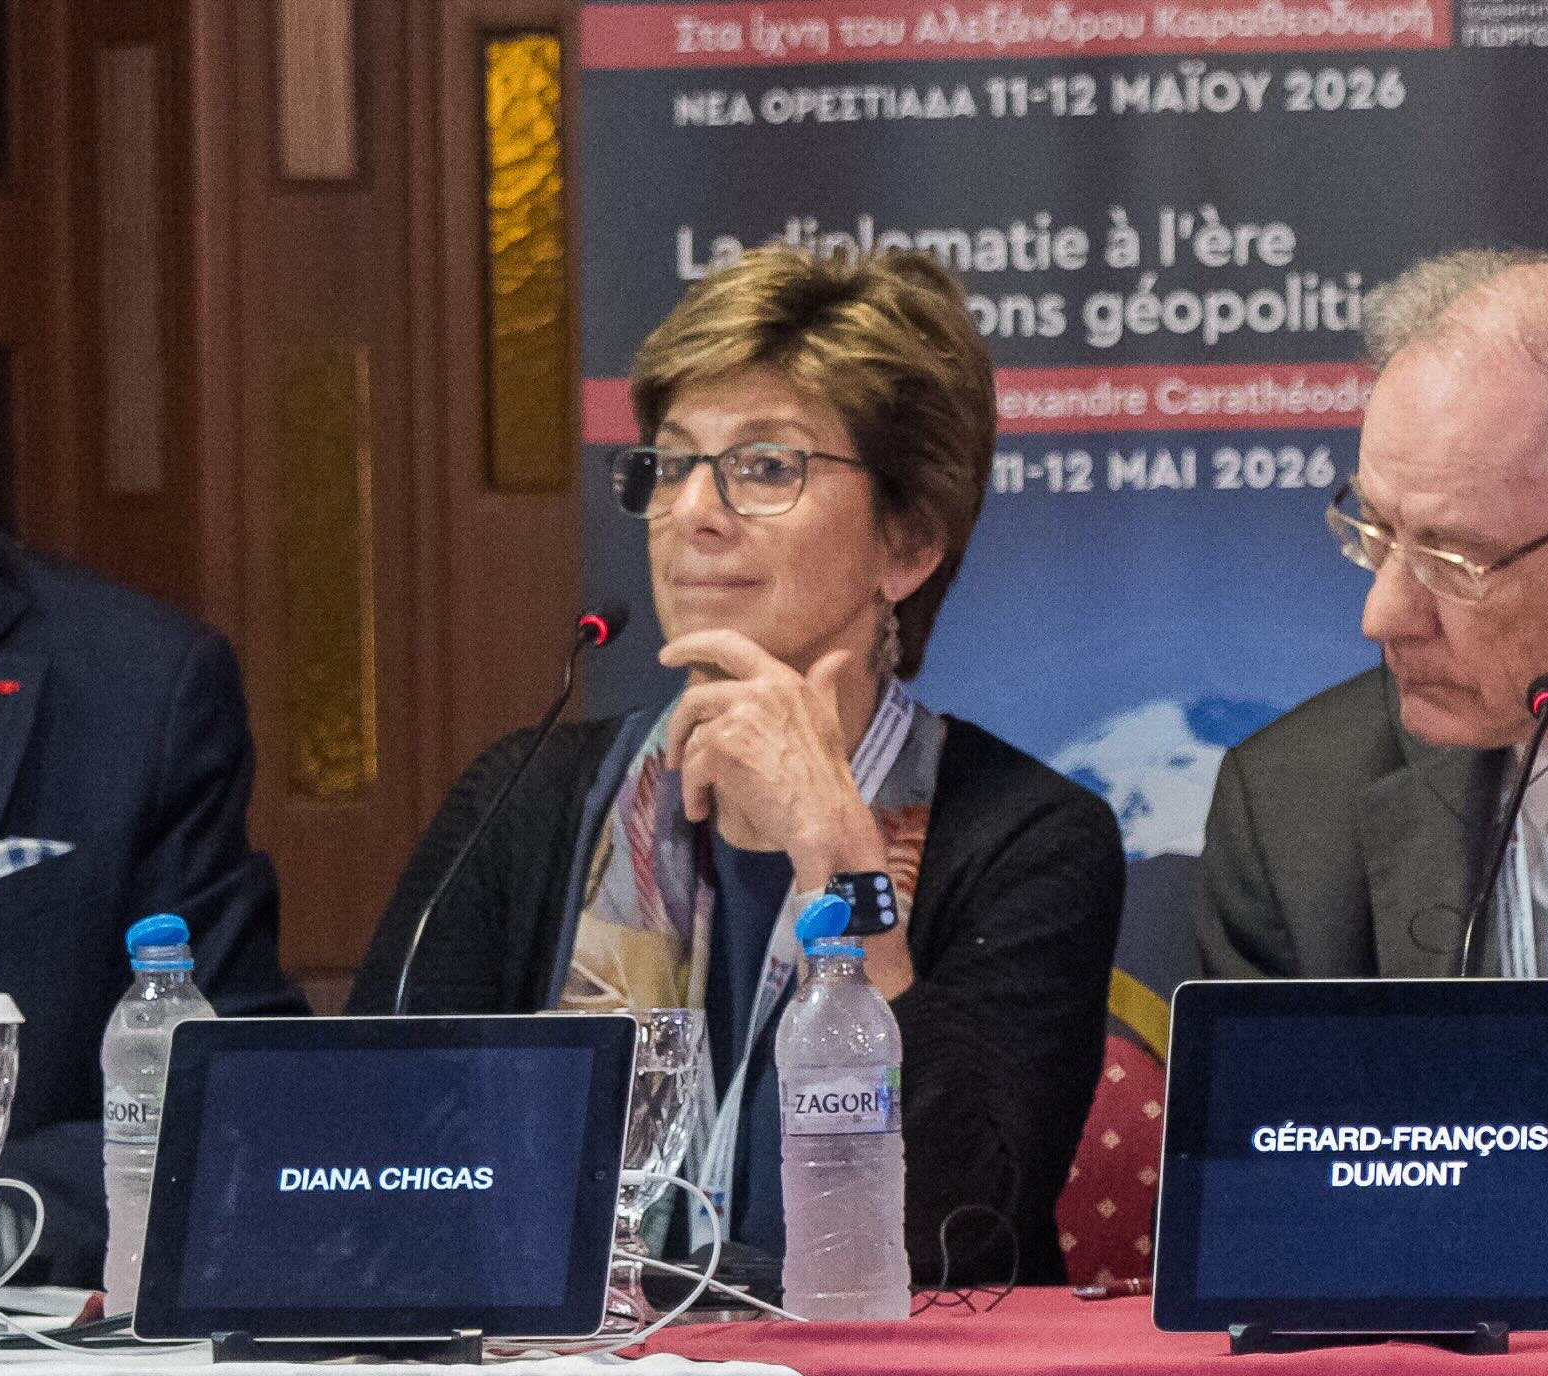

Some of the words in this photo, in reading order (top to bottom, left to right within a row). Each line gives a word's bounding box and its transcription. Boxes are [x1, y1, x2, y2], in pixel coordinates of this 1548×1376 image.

[840, 15, 906, 49] του
[916, 2, 1145, 52] Αλεξάνδρου
[674, 91, 754, 127] ΝΕΑ
[760, 79, 978, 126] ΟΡΕΣΤΙΑΔΑ
[984, 73, 1097, 119] 11-12
[1110, 58, 1273, 115] ΜΑΪΟΥ
[1283, 68, 1407, 111] 2026
[1104, 204, 1143, 270] à
[1158, 203, 1298, 269] l'ère
[1083, 270, 1363, 349] géopoliti
[998, 376, 1146, 421] exandre
[991, 451, 1095, 496] 11-12
[1107, 447, 1198, 491] MAI
[1214, 443, 1337, 490] 2026
[107, 1101, 147, 1123] GORI
[795, 1091, 880, 1114] ZAGORI
[278, 1167, 372, 1193] DIANA
[378, 1166, 494, 1192] CHIGAS
[1331, 1160, 1468, 1188] DUMONT
